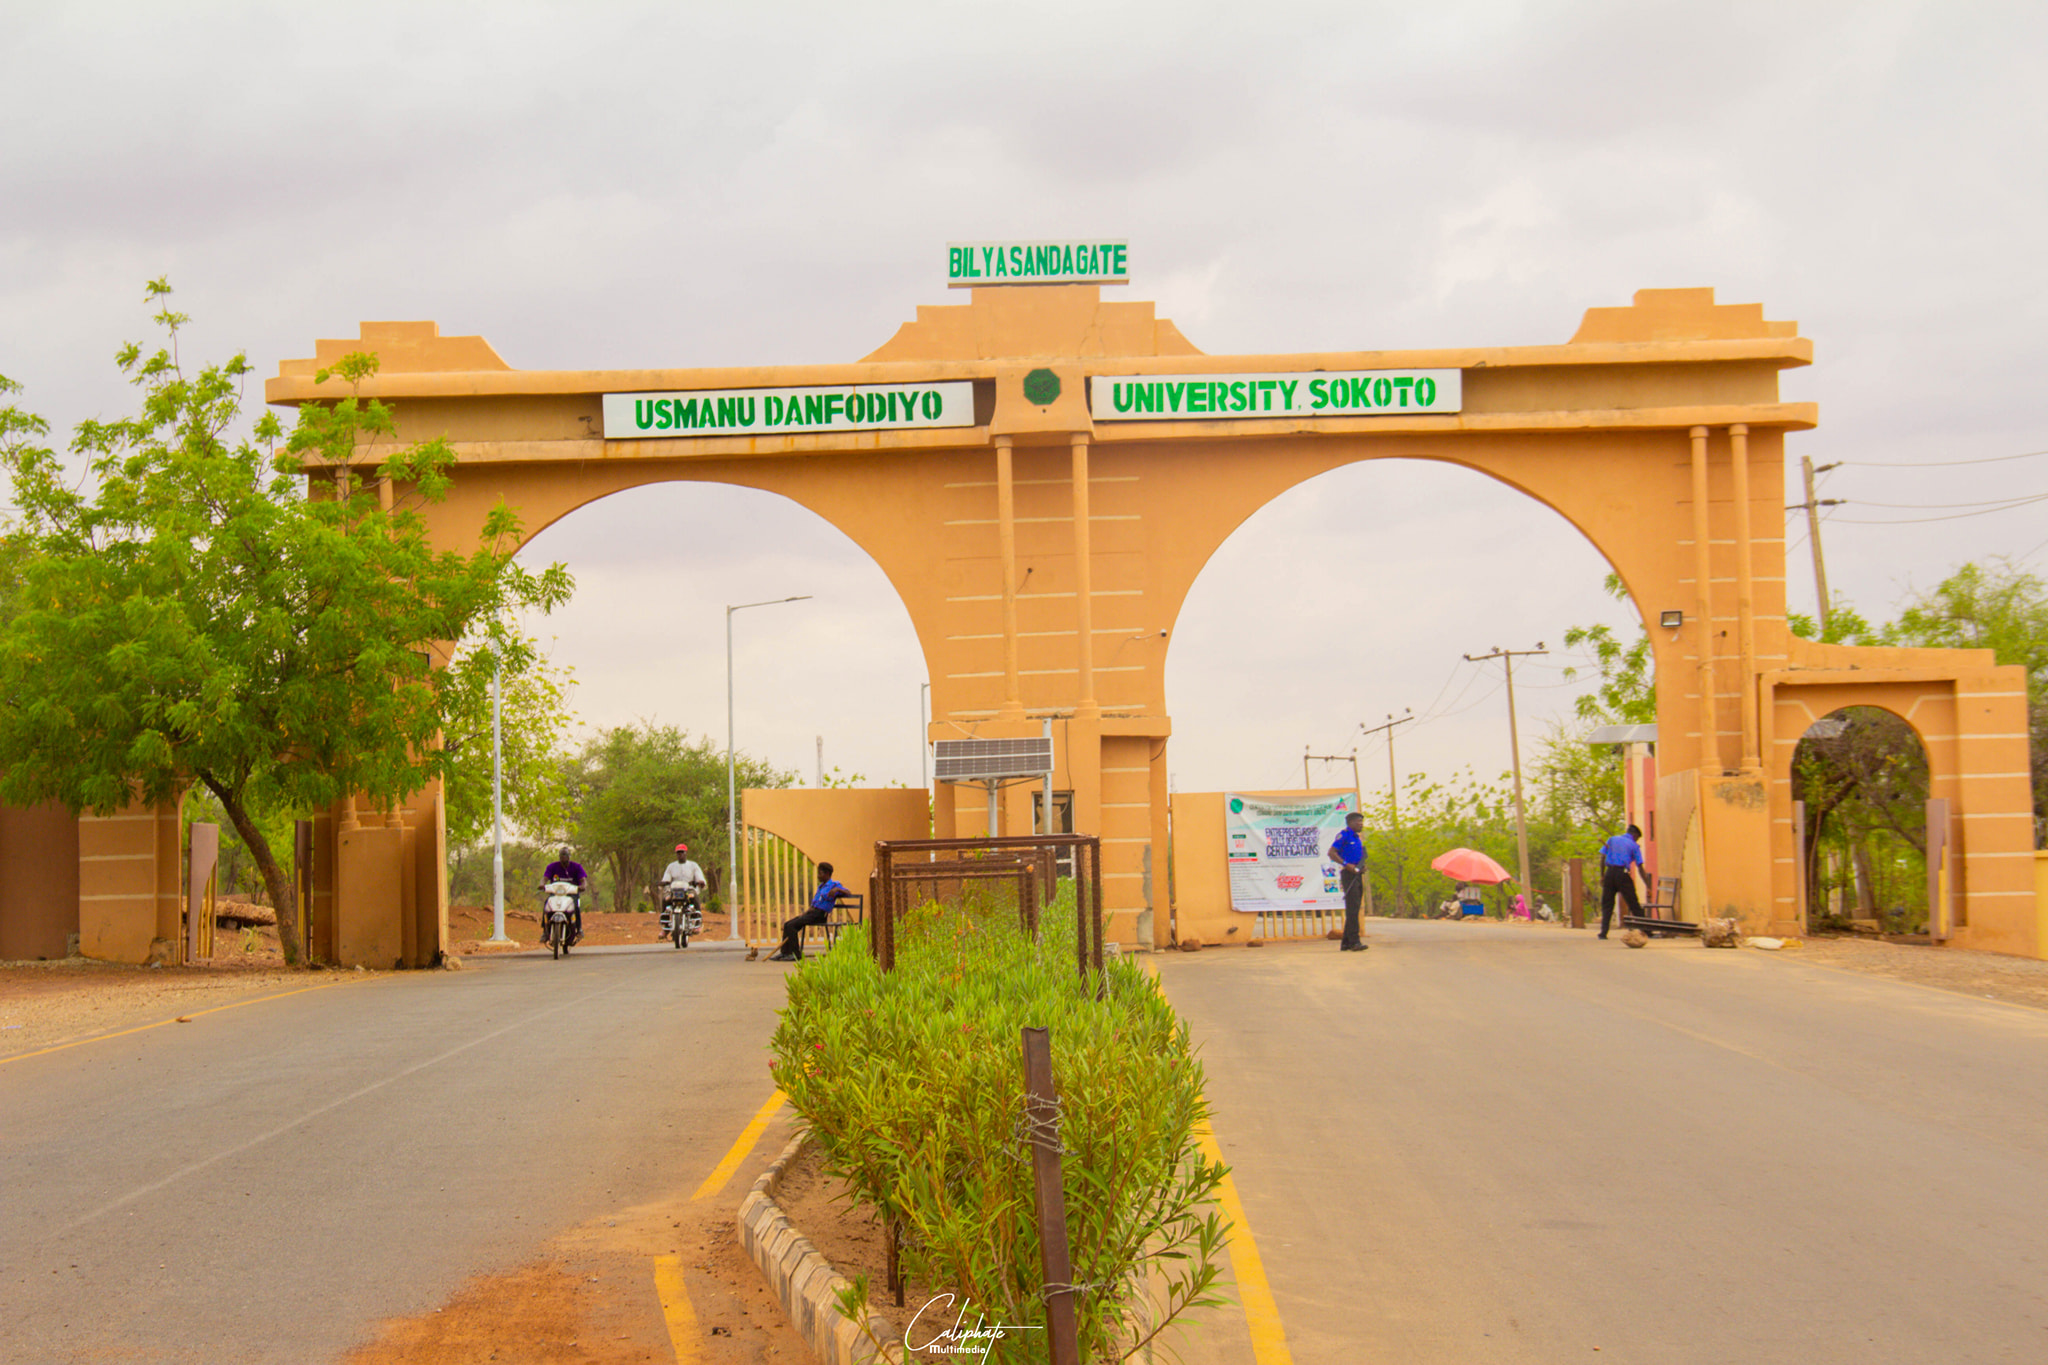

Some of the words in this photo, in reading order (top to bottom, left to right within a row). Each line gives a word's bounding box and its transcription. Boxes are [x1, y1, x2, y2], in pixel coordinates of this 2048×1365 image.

[635, 396, 756, 430] USMANU
[763, 390, 943, 427] DANFODIYO
[1308, 376, 1437, 410] SOKOTO
[1266, 844, 1320, 857] CERTIFICATIONS
